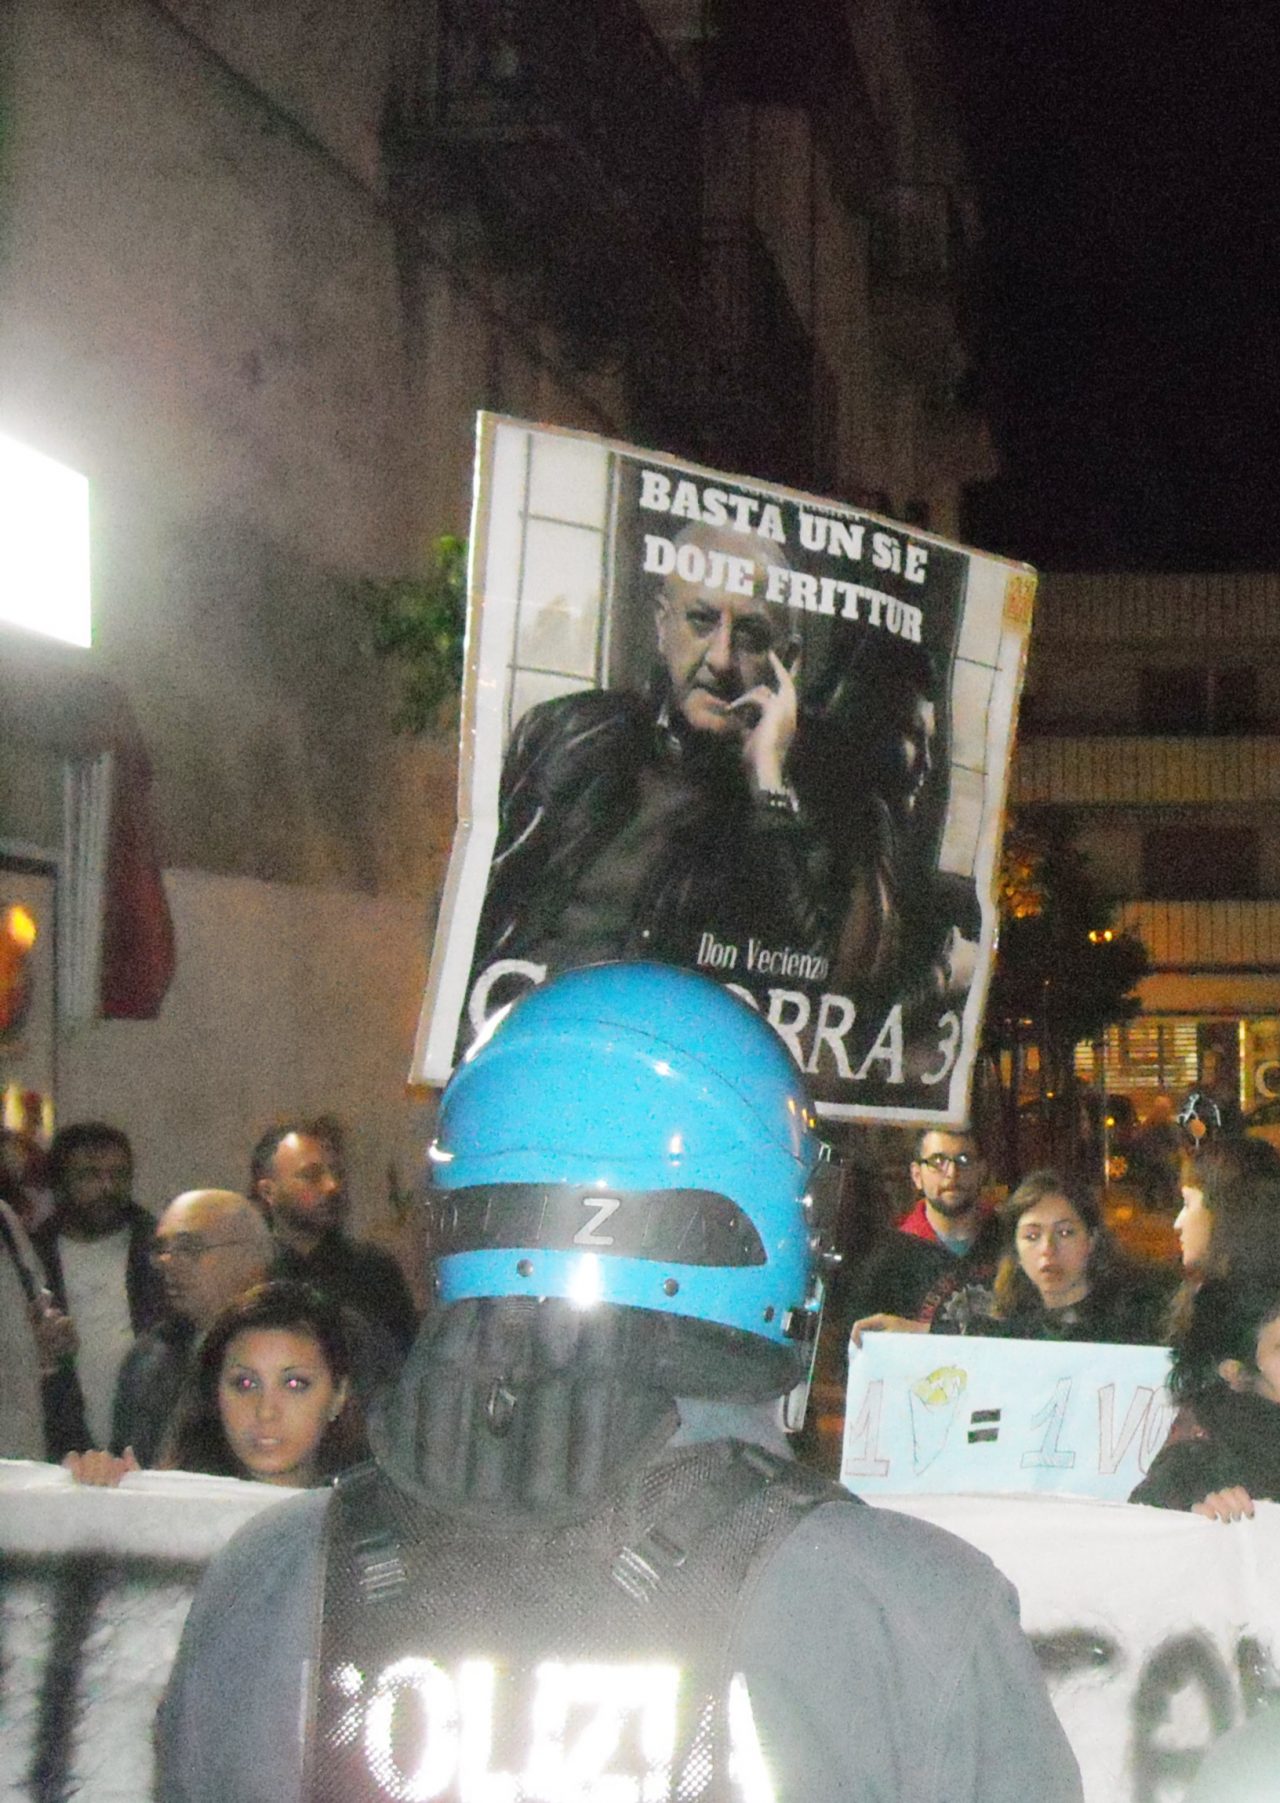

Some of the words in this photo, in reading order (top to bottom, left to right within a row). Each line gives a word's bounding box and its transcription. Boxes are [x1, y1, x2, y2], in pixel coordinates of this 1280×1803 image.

[639, 470, 786, 544] BASTA
[799, 512, 865, 560] UN
[643, 533, 754, 598] DOJE
[766, 564, 922, 643] FRITTUR
[697, 932, 738, 970] Don
[920, 1009, 960, 1085] 3
